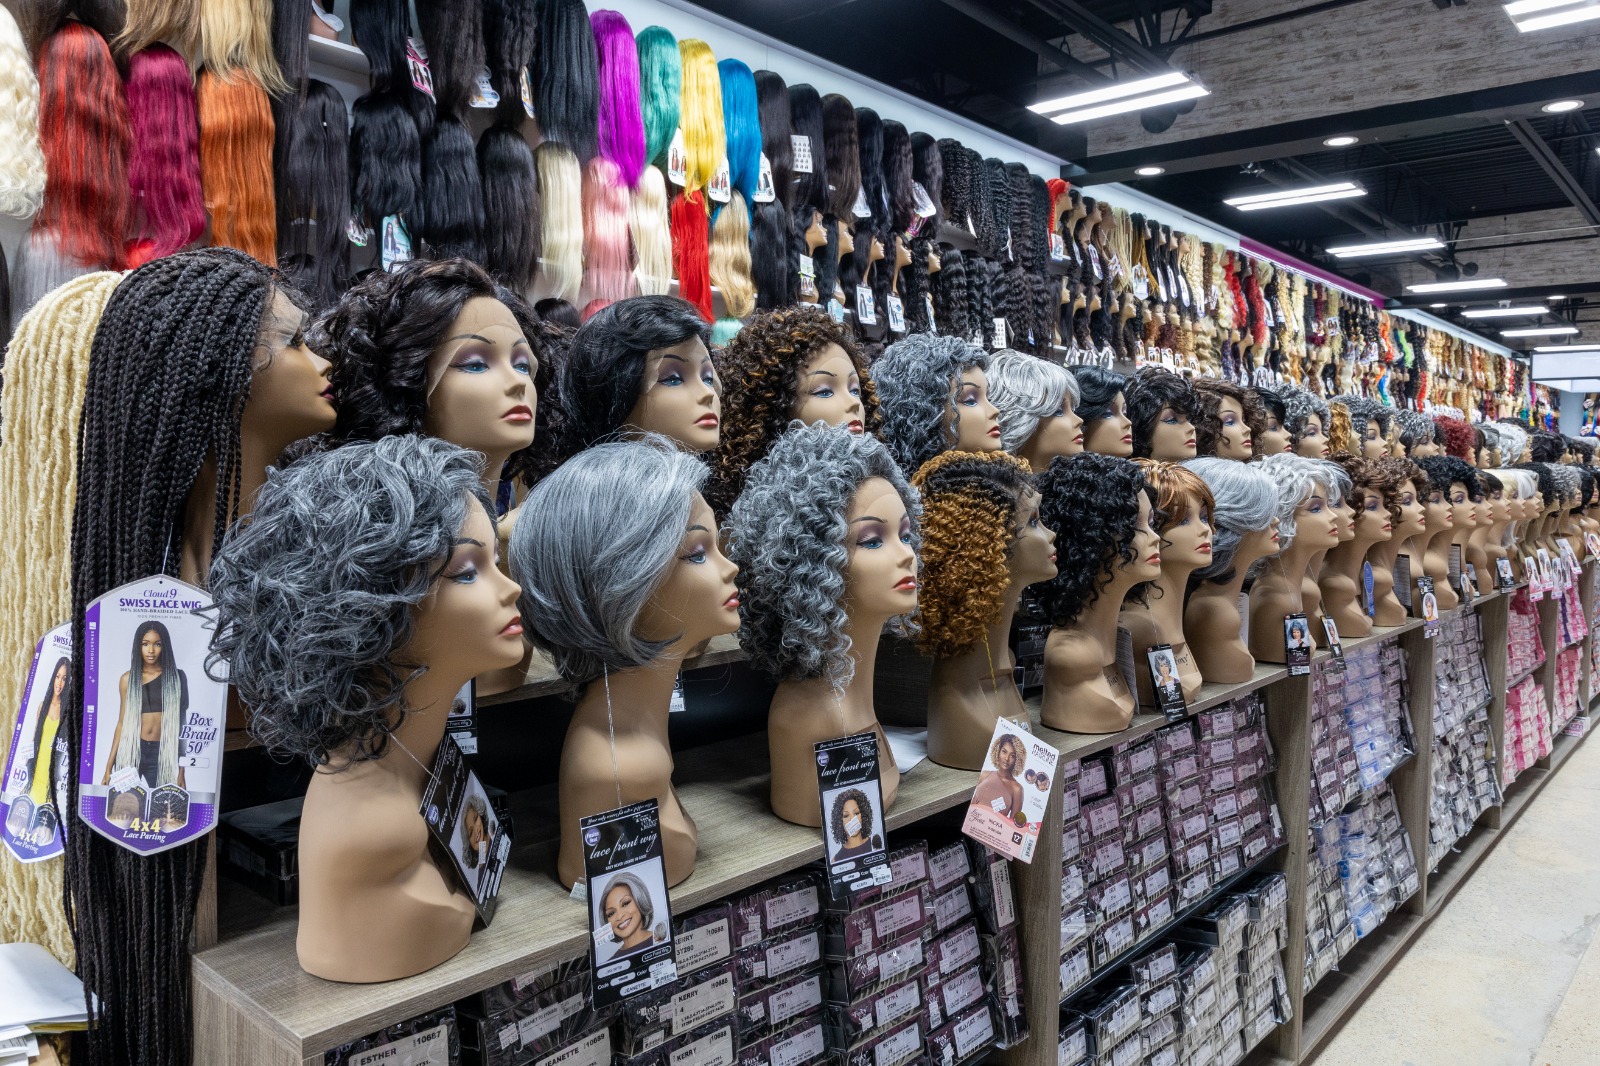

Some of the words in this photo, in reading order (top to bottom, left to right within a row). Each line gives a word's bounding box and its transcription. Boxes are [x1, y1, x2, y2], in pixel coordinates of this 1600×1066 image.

[144, 590, 168, 598] Cloud
[170, 588, 178, 598] 9
[120, 598, 150, 608] SWISS
[153, 600, 179, 608] LACE
[181, 600, 202, 610] WIG
[188, 712, 213, 726] Box
[180, 726, 218, 741] Braid
[186, 741, 209, 754] 50"
[190, 758, 196, 766] 2
[13, 767, 28, 782] HD
[822, 766, 838, 777] lace
[836, 757, 859, 783] front
[860, 758, 876, 776] wig
[130, 817, 162, 833] 4x4
[19, 827, 38, 844] 4x4
[123, 830, 139, 840] Lace
[140, 832, 167, 844] Parting
[12, 838, 23, 848] Lace
[22, 843, 39, 854] Parting
[590, 844, 612, 860] lace
[608, 832, 639, 865] front
[640, 831, 658, 853] wig
[678, 990, 698, 1002] KERRY
[360, 1048, 397, 1066] ESTHER
[676, 1048, 697, 1061] KERRY
